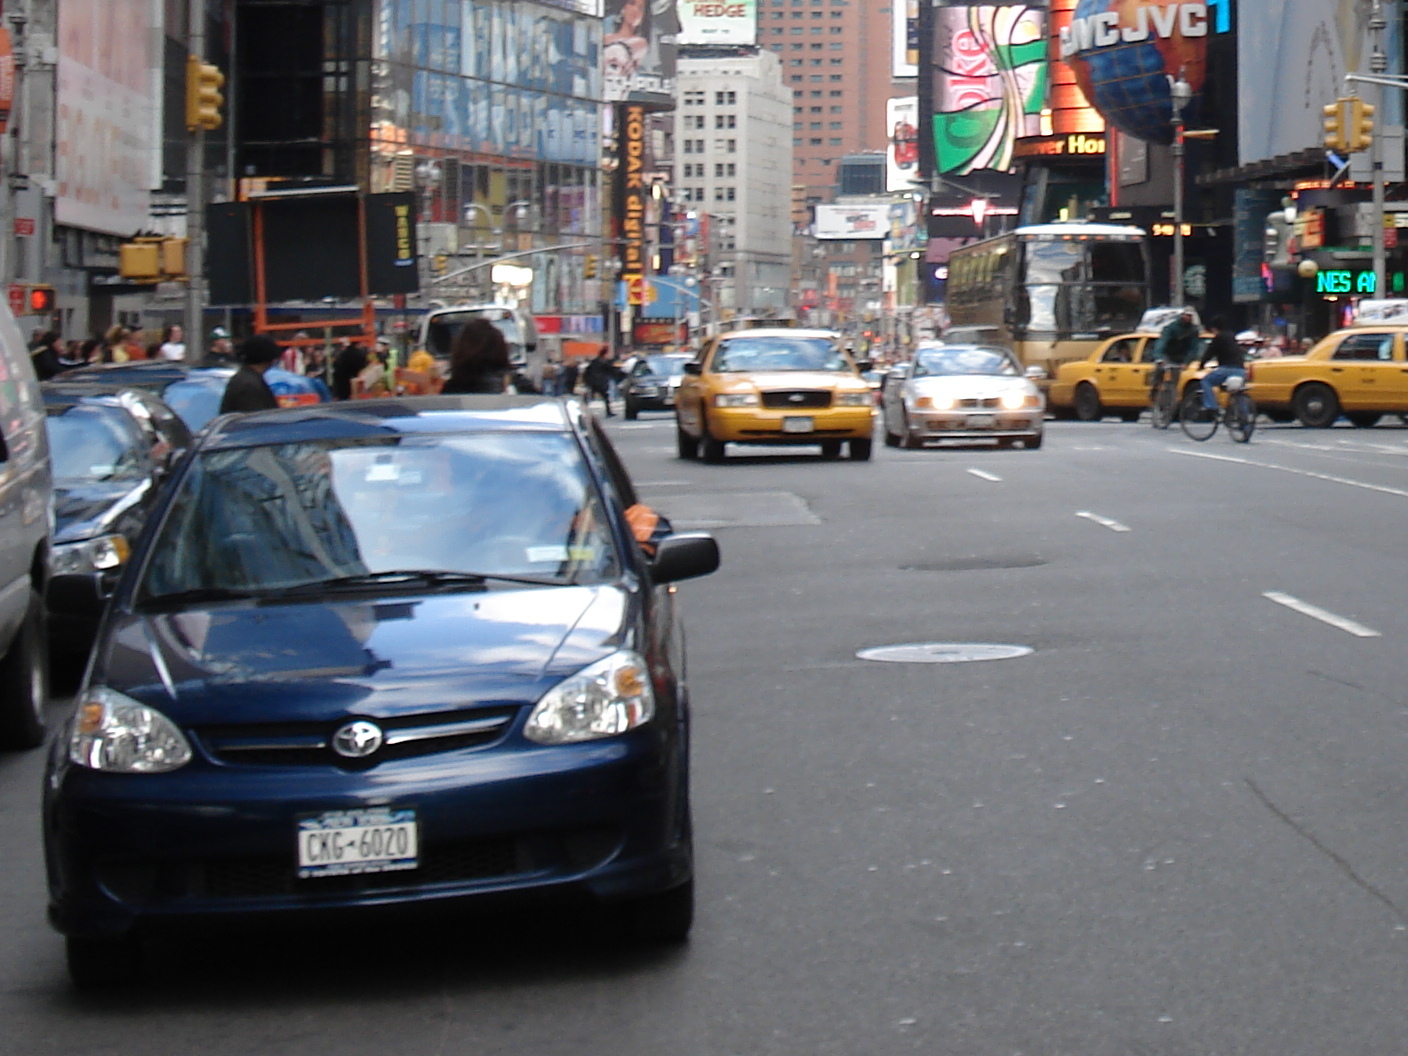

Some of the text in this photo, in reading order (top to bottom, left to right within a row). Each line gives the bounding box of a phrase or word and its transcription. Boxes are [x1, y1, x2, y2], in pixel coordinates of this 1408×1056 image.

[693, 4, 746, 18] HEDGE
[1121, 2, 1208, 43] JVC
[626, 106, 643, 188] KODAK
[1317, 271, 1351, 293] NES
